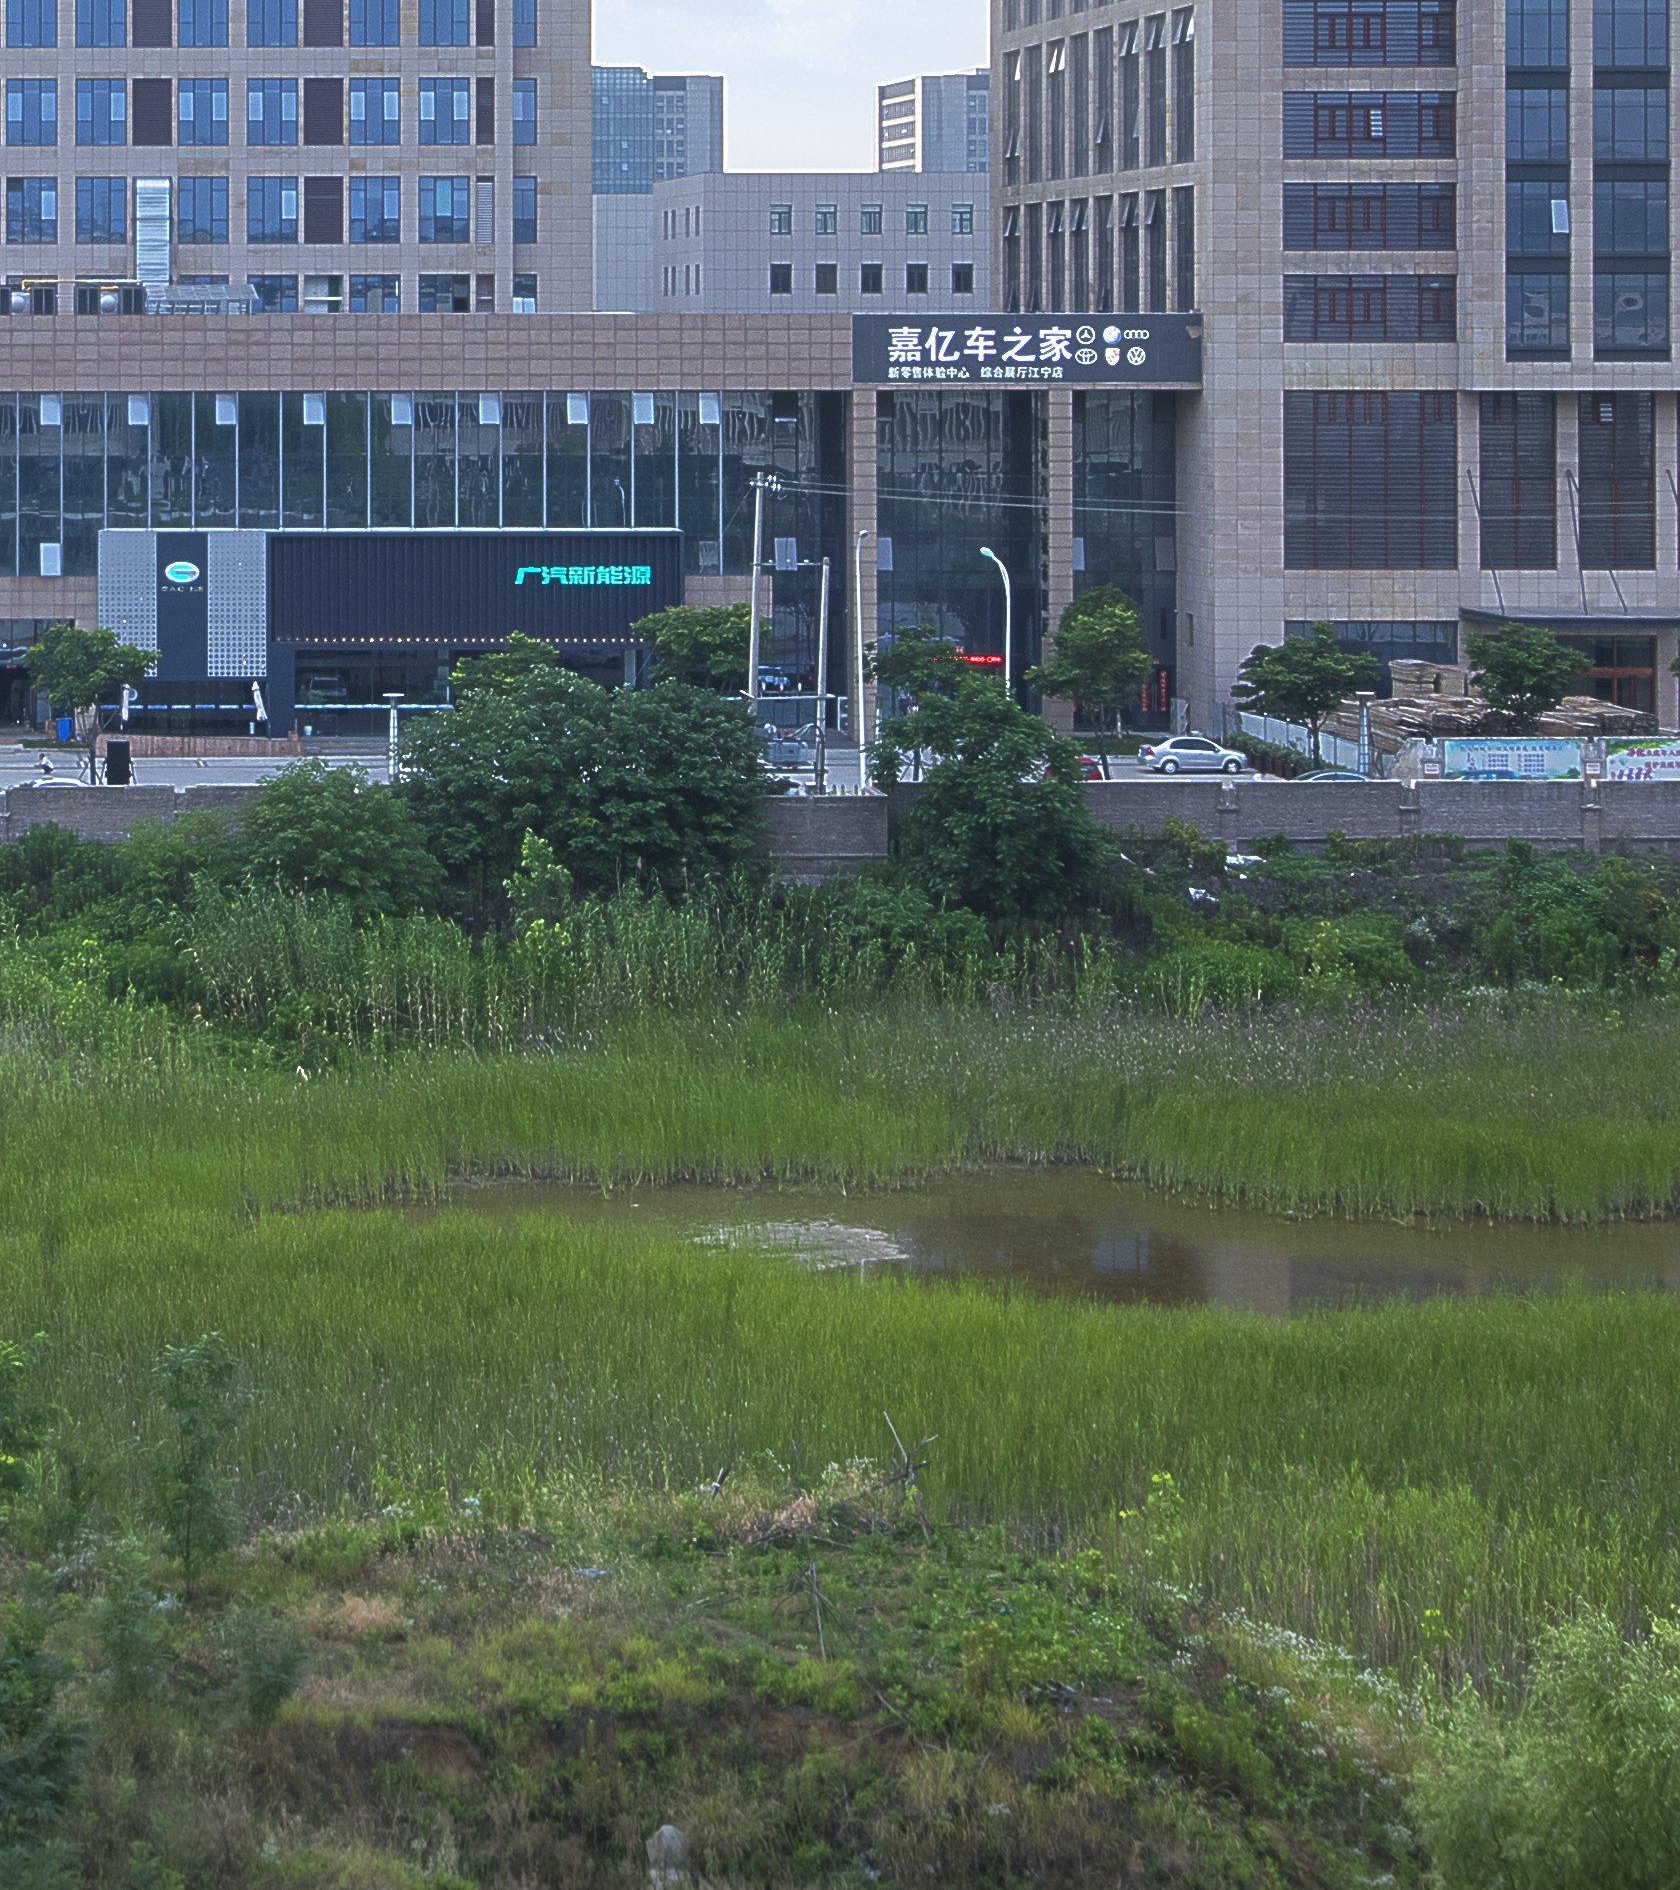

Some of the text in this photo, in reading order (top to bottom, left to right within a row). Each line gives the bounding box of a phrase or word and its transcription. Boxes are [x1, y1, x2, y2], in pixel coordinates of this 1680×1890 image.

[888, 326, 1073, 362] 嘉亿车之家
[887, 366, 1064, 379] 新零售体验中心 综合展厅江宁店
[514, 566, 652, 585] 广汽新能源
